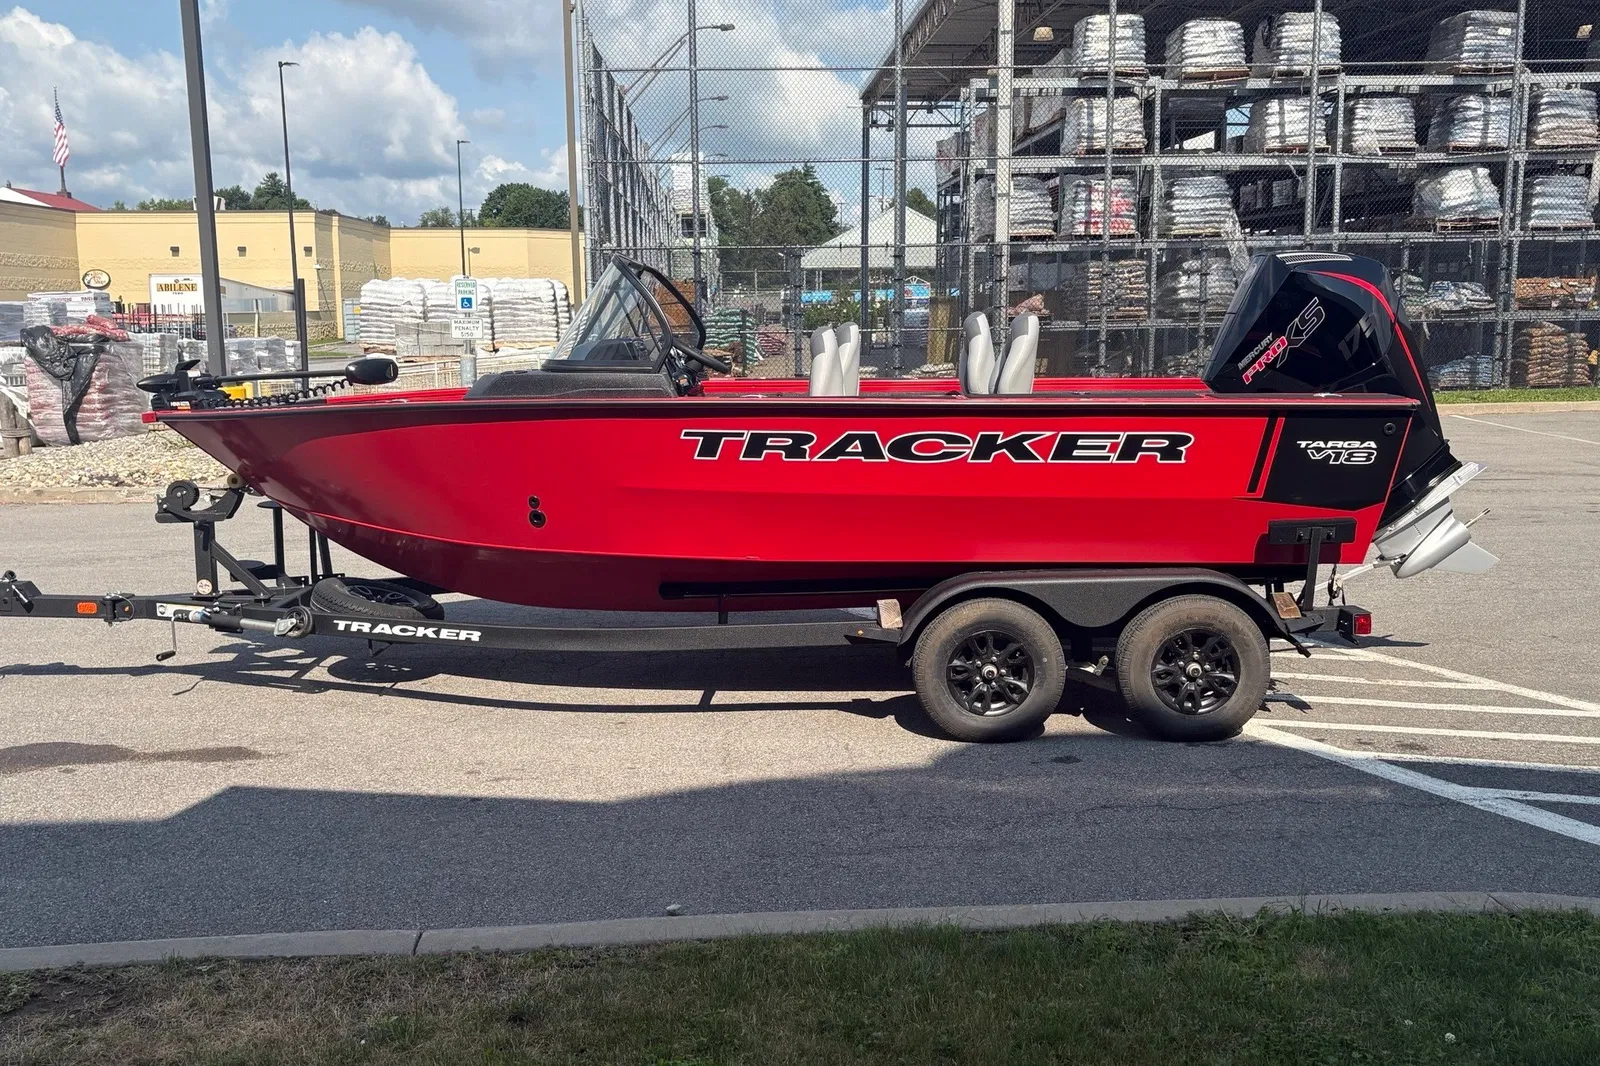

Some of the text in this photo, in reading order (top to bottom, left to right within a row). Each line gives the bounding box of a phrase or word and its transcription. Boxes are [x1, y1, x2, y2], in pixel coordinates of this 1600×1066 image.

[157, 283, 197, 292] ABILENE
[1237, 332, 1273, 371] MERCURY
[1242, 296, 1326, 385] PRO XS
[1338, 313, 1377, 362] 175
[680, 429, 1195, 464] TRACKER
[1296, 440, 1377, 449] TARGA
[1306, 449, 1377, 464] V18
[333, 619, 482, 642] TRACKER
